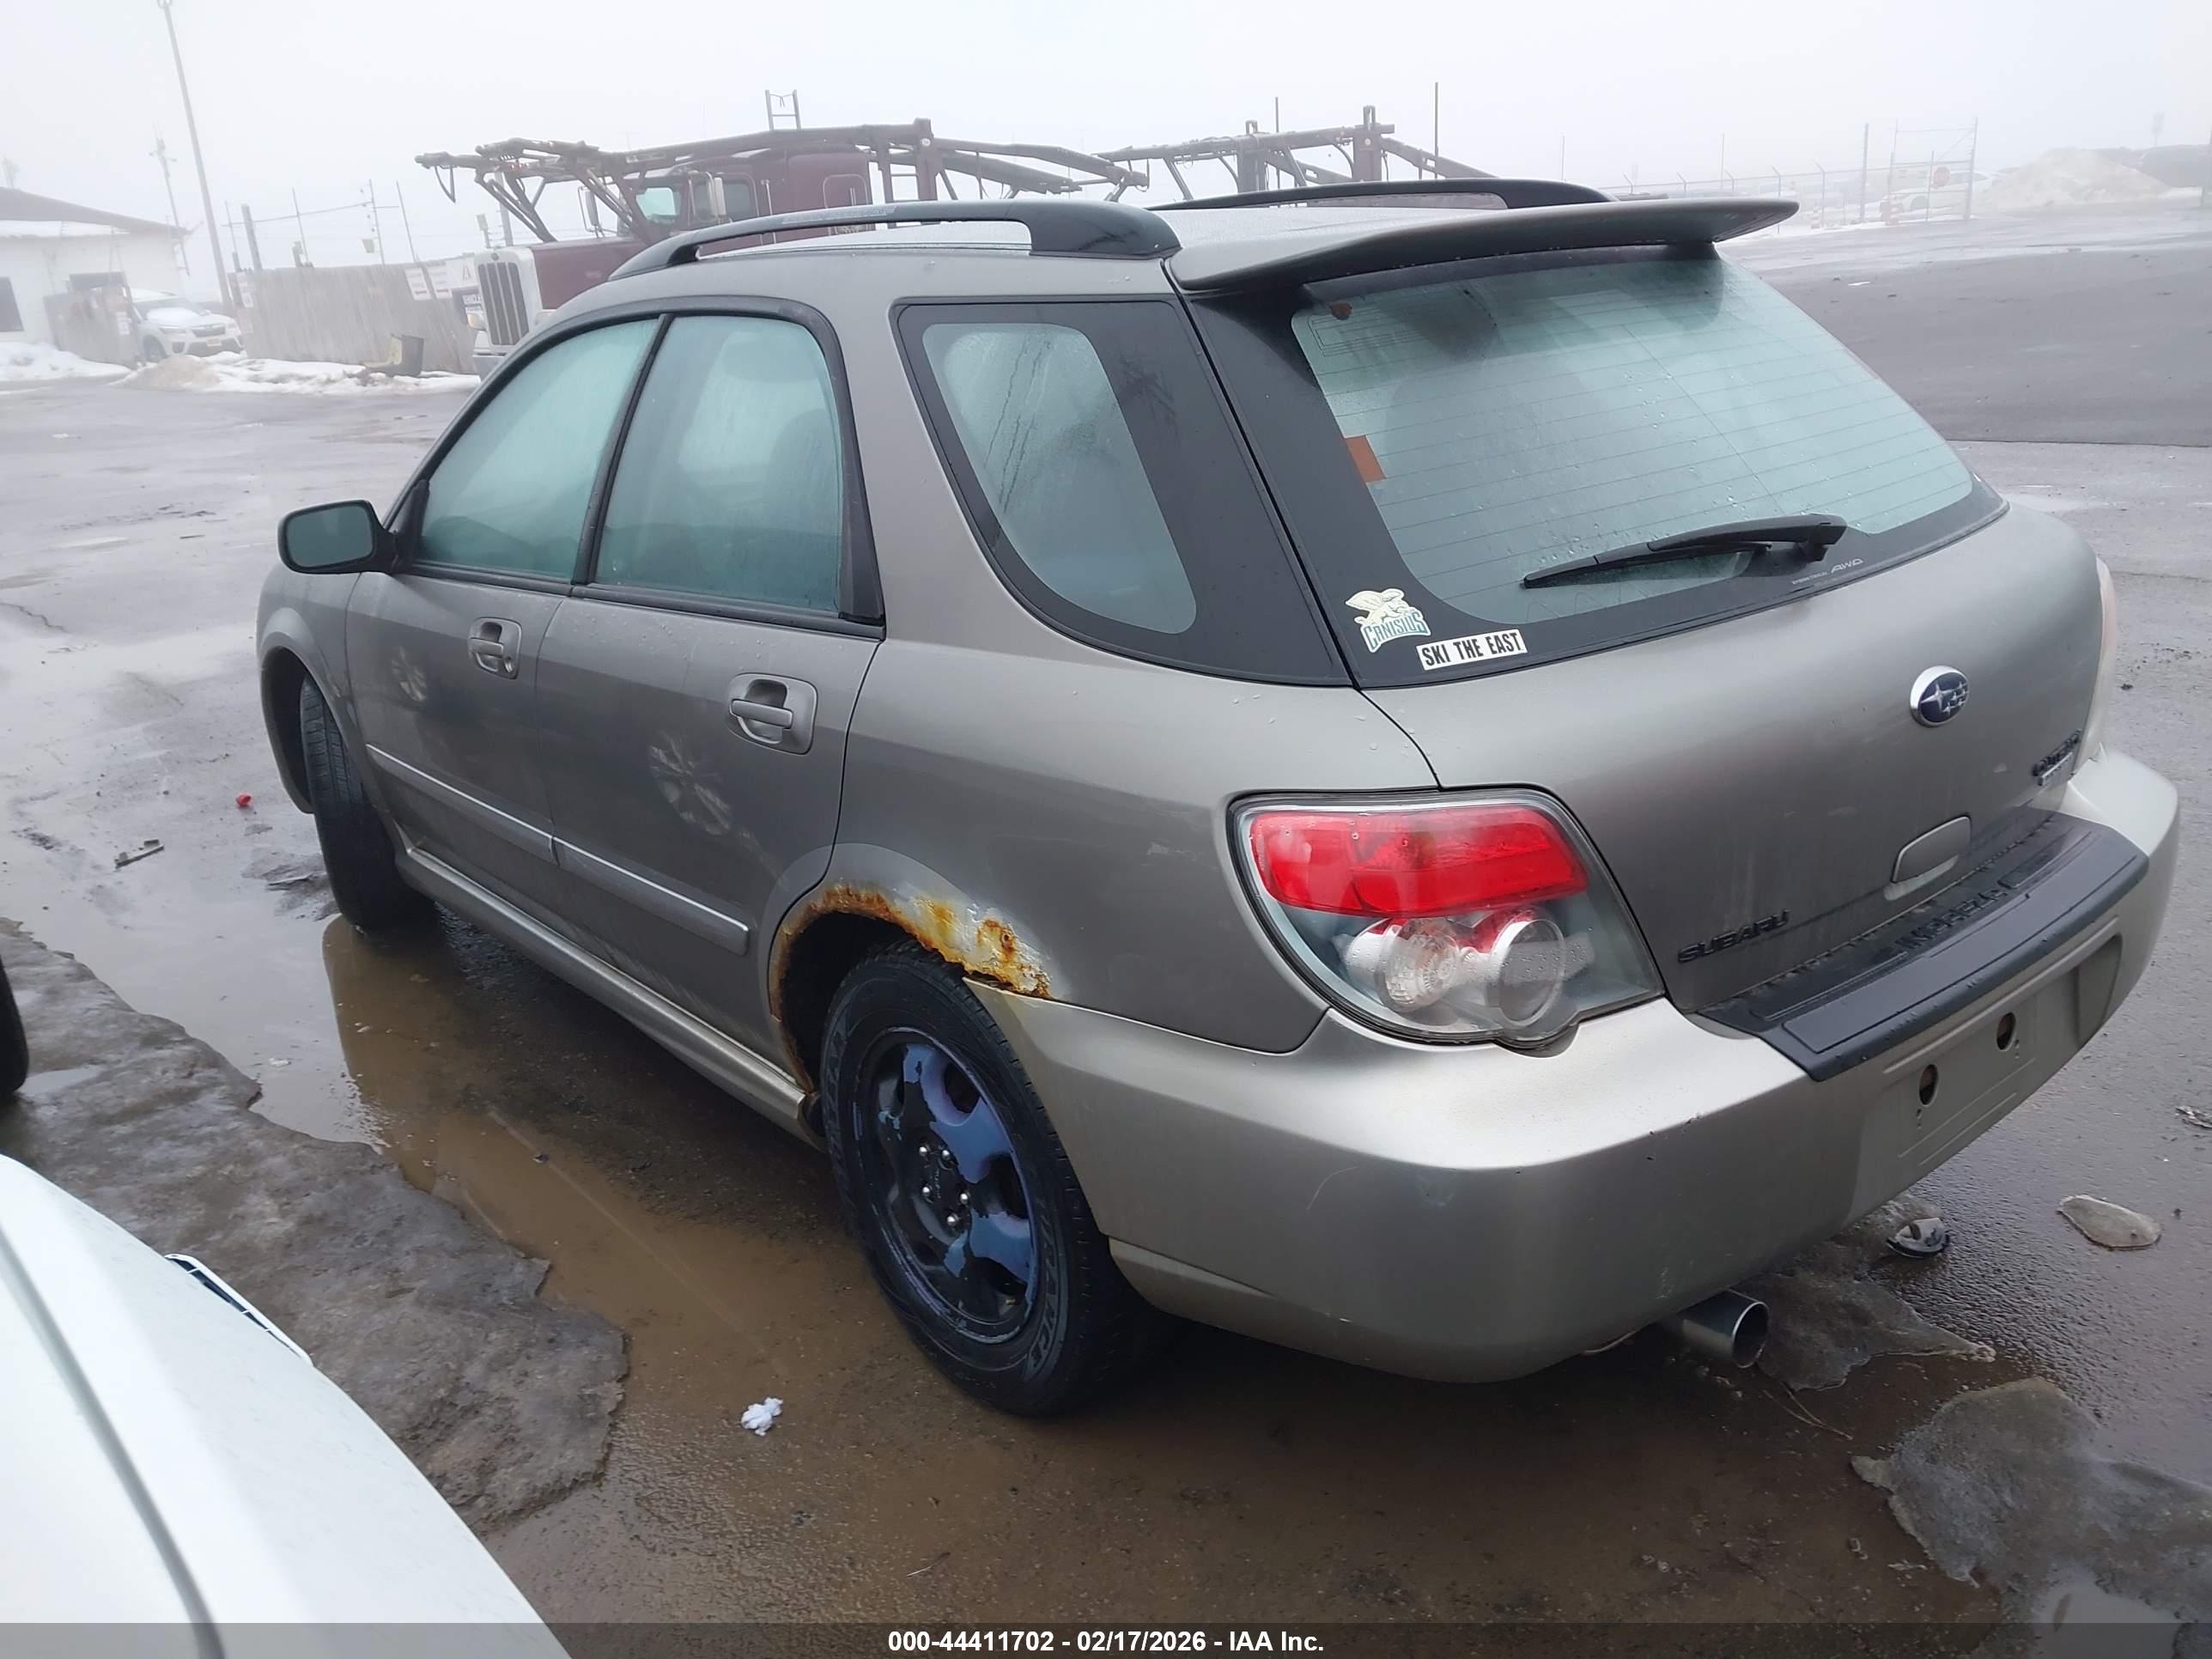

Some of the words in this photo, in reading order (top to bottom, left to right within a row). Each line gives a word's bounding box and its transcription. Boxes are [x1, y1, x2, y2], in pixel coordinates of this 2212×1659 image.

[1831, 558, 1863, 574] AWD
[1363, 609, 1426, 646] CANISIUS
[1421, 642, 1451, 666] SKI
[1453, 636, 1484, 660] THE
[1486, 632, 1521, 655] EAST
[1678, 908, 1790, 963] SUBARU
